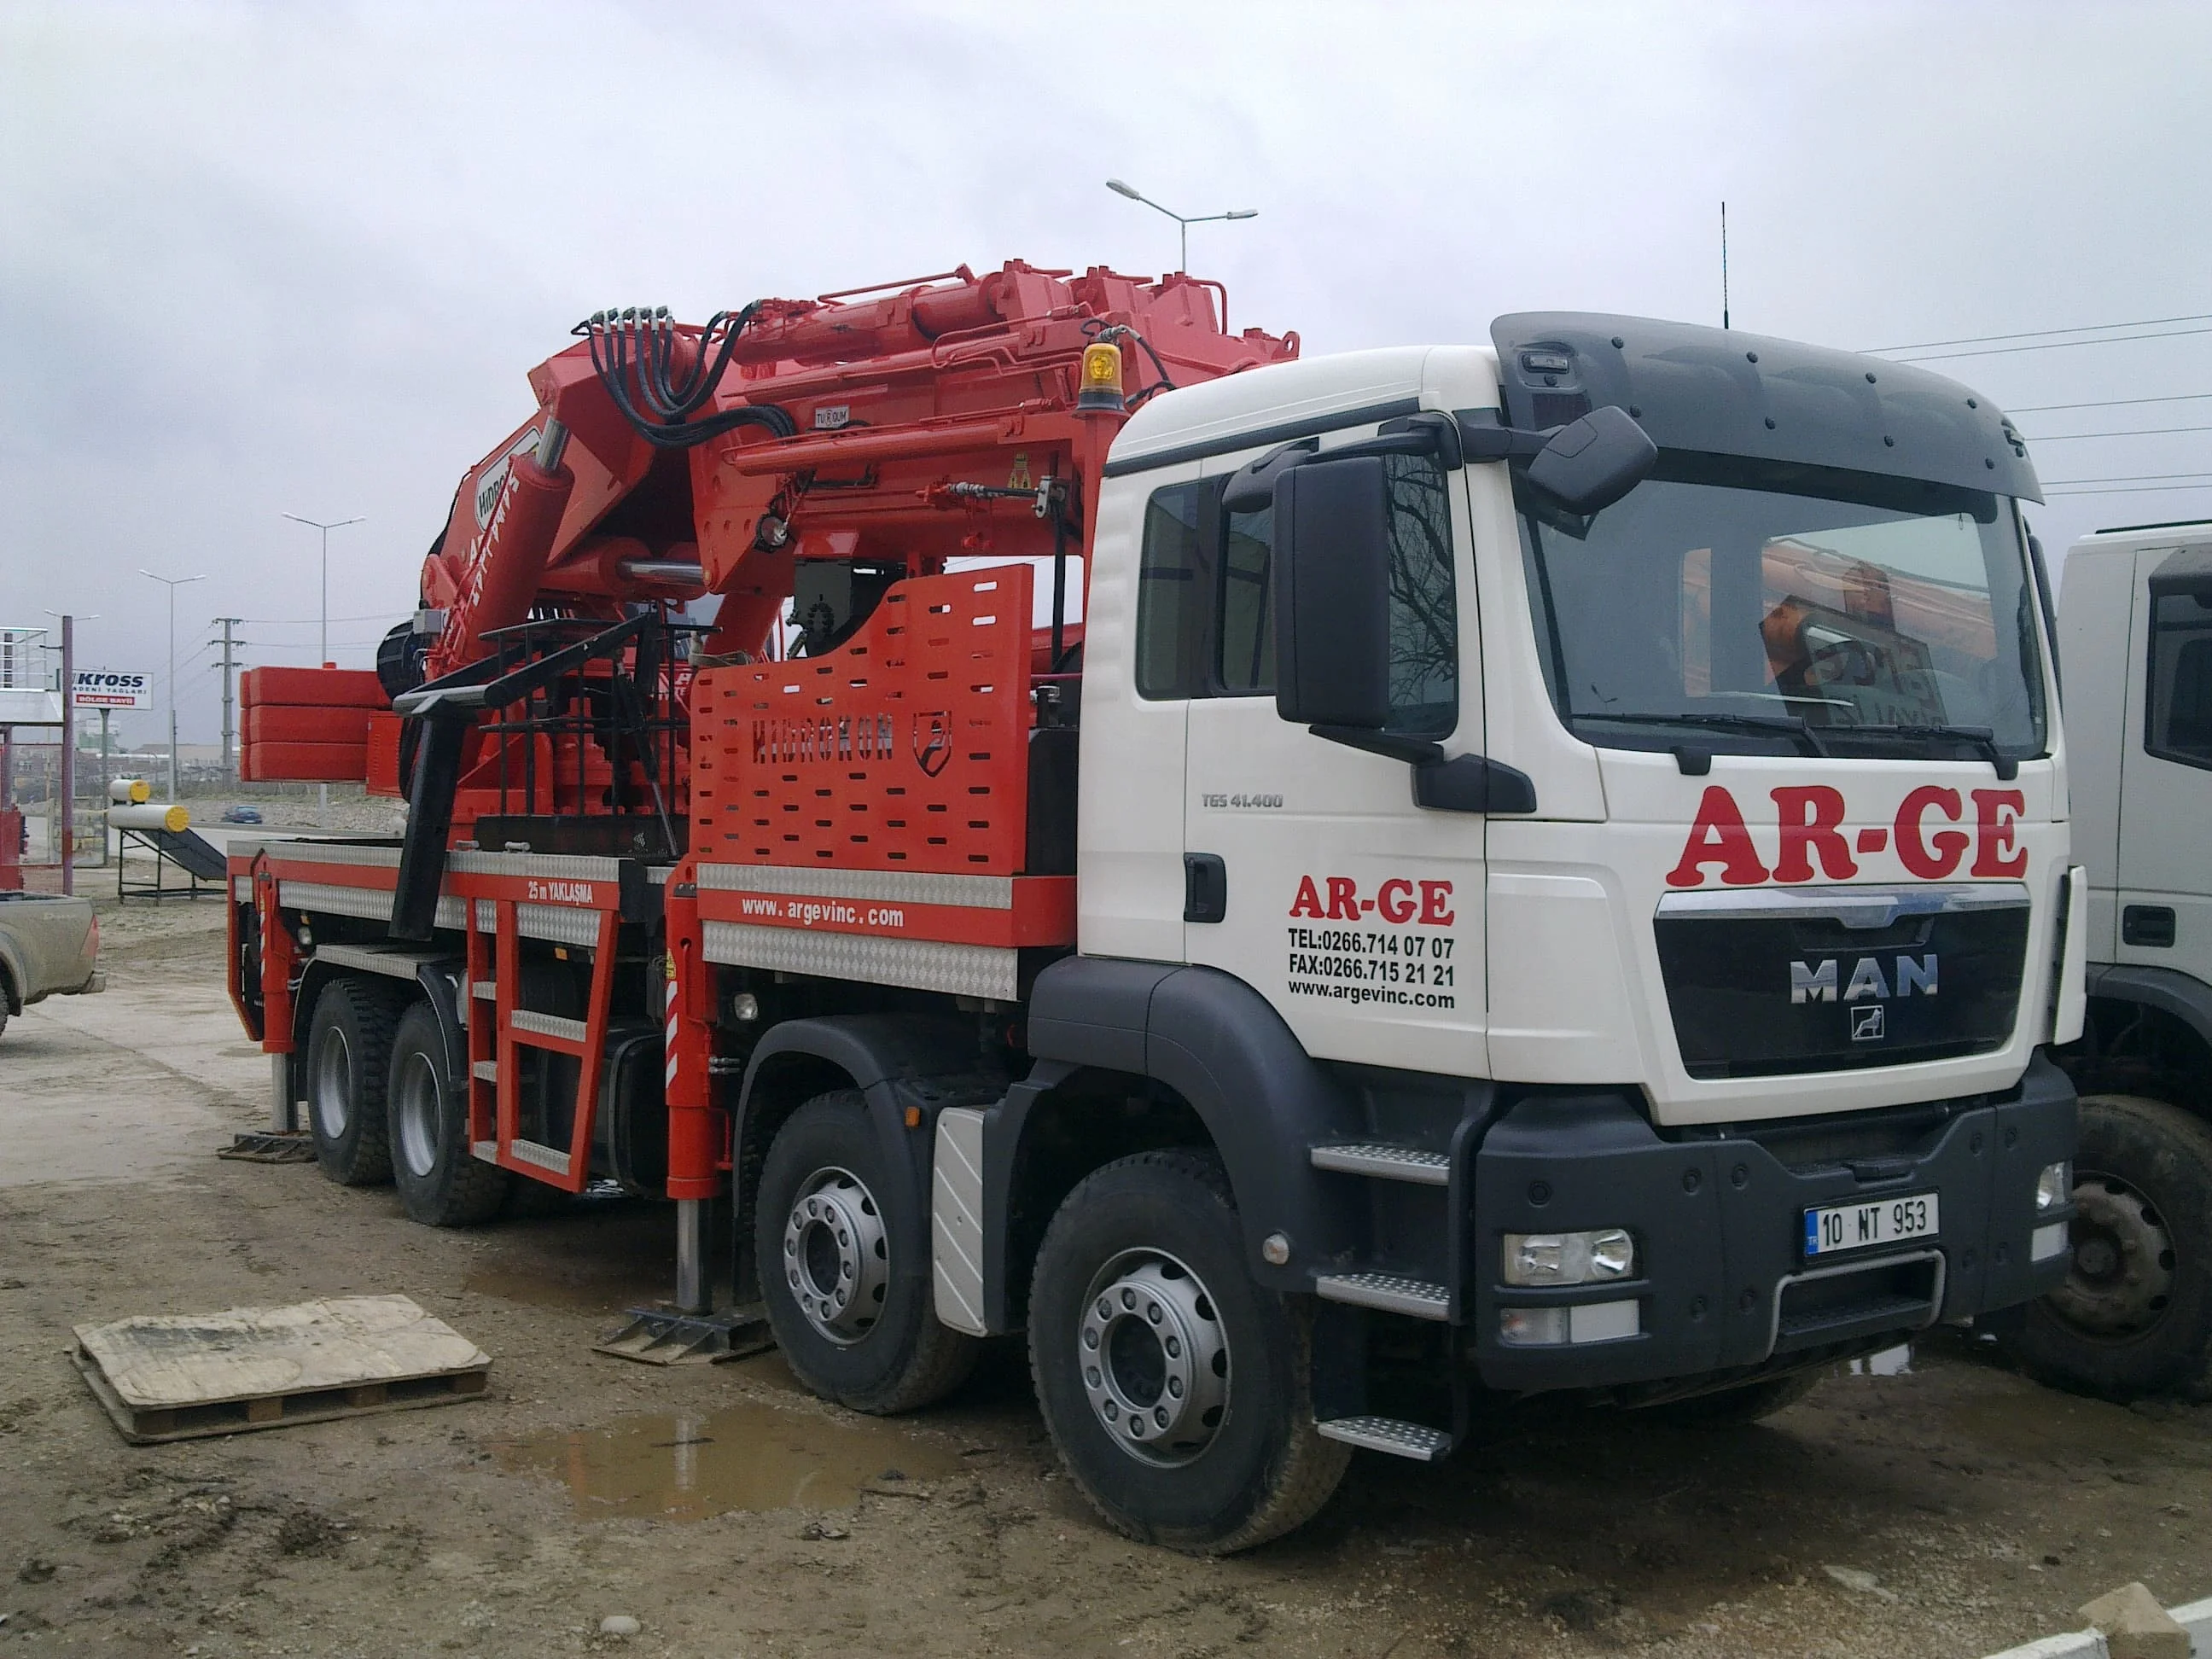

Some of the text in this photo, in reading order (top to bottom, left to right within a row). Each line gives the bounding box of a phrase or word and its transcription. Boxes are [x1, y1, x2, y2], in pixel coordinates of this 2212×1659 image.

[1202, 794, 1284, 807] TGS 41.400
[1666, 785, 2028, 887] AR-GE
[528, 881, 593, 905] 25 m YAKLAŞMA
[1289, 876, 1454, 926] AR-GE
[1289, 928, 1454, 958] TEL:0266.714 07 07
[1289, 953, 1454, 987] FAX:0266.715 21 21
[1790, 954, 1938, 1004] MAN
[1289, 981, 1454, 1009] www.argevinc.com
[1823, 1201, 1926, 1246] 10 NT 953
